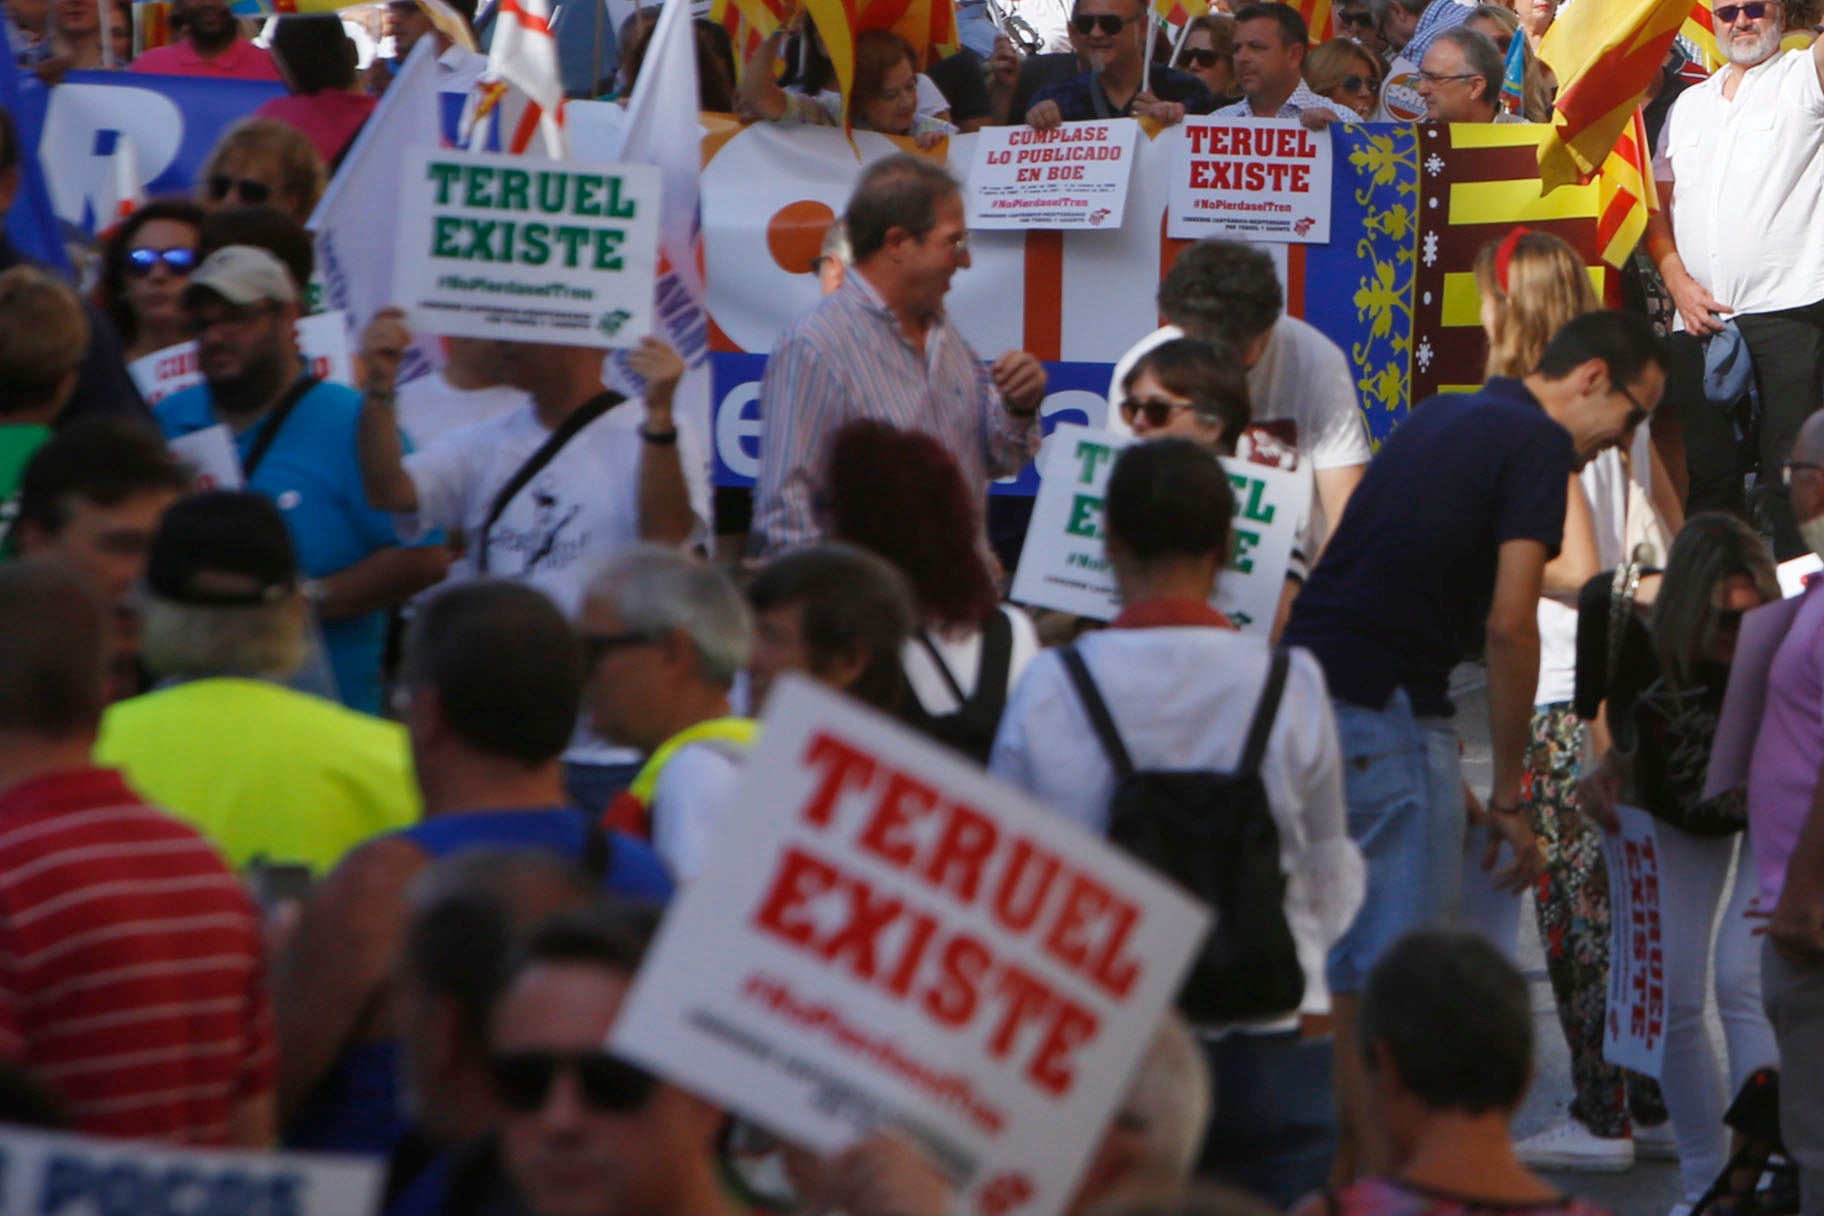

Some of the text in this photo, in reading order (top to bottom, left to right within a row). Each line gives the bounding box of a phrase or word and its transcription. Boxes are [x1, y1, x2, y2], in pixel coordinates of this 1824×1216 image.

[986, 145, 1122, 165] LO PUBLICADO
[1186, 125, 1317, 158] TERUEL
[426, 161, 637, 220] TERUEL
[1016, 166, 1085, 182] EN BOE
[1189, 161, 1310, 192] EXISTE
[991, 197, 1089, 209] #NoPierdaselTren
[1193, 199, 1292, 212] #NoPierdaselTren
[431, 216, 626, 271] EXISTE
[800, 728, 1142, 1001] TERUEL
[1626, 839, 1649, 1040] EXISTE
[1642, 834, 1663, 1052] TERUEL
[753, 846, 1103, 1101] EXISTE
